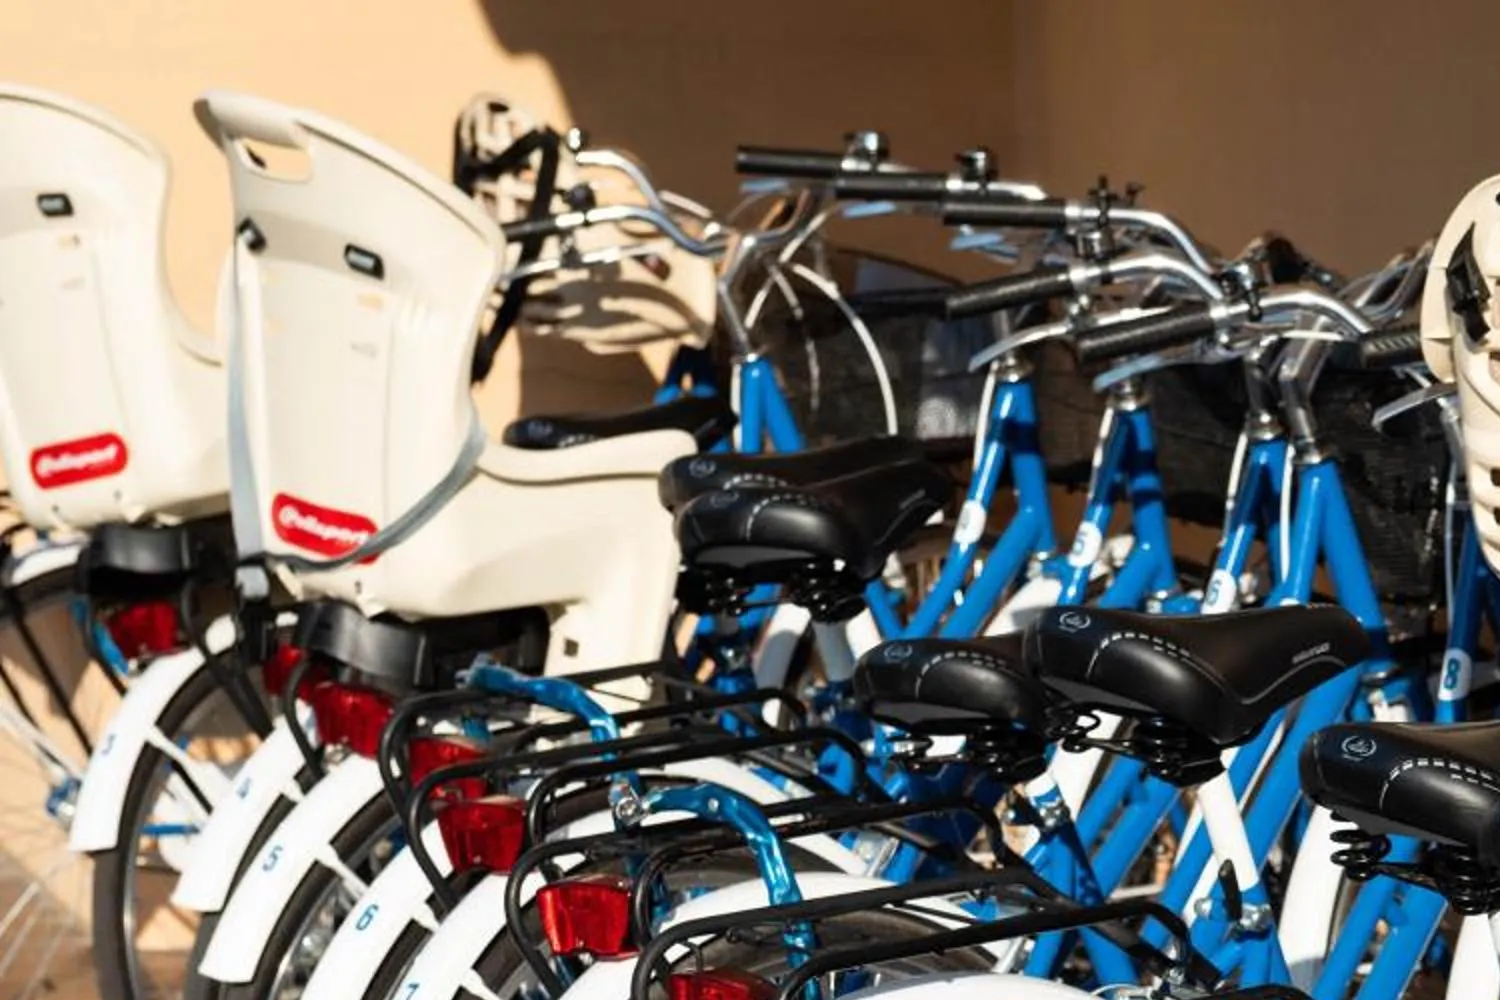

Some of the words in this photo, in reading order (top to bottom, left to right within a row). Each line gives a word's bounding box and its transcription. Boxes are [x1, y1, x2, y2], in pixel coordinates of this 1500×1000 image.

[1444, 658, 1461, 690] 8
[262, 845, 284, 872] 5
[356, 903, 379, 931] 6
